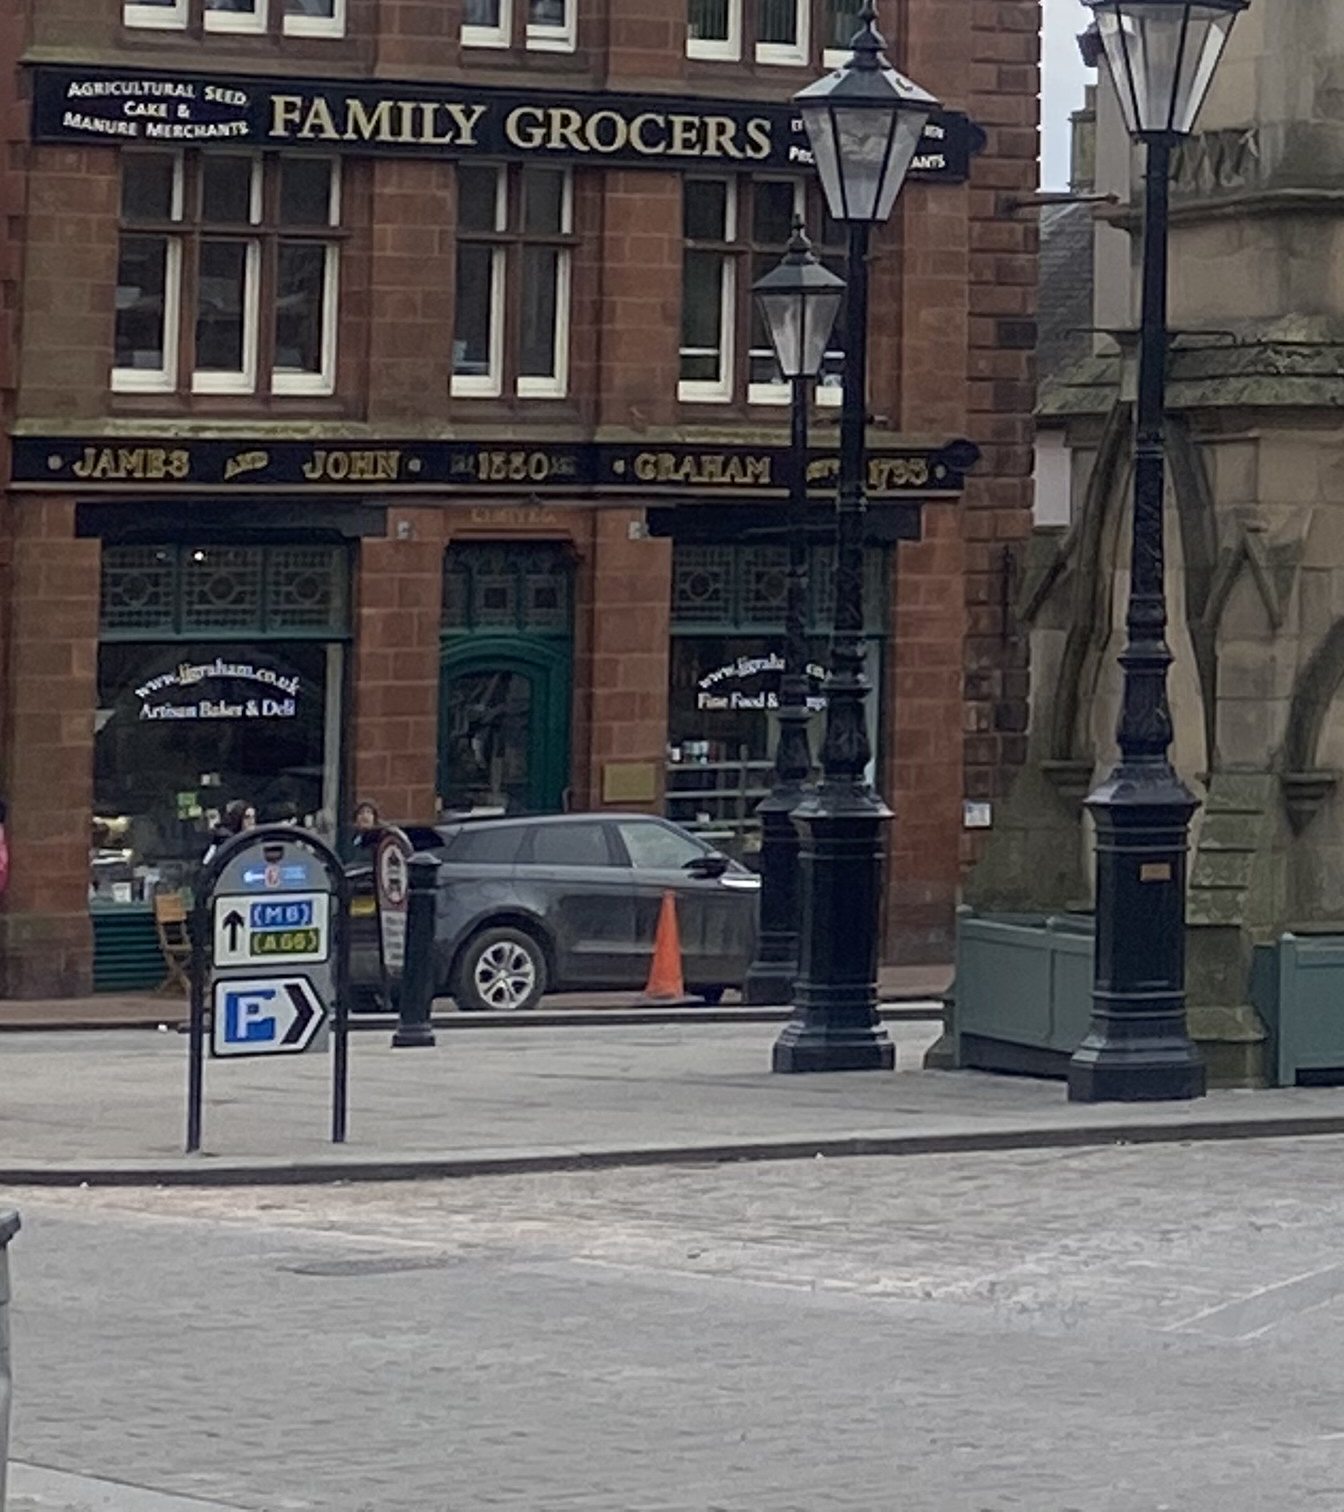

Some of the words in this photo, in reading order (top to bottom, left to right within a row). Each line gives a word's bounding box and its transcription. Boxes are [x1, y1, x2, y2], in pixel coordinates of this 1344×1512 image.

[67, 81, 196, 98] AGRICULTURAL
[204, 86, 248, 106] SEED
[123, 100, 169, 118] CAKE
[176, 103, 191, 119] &
[62, 111, 138, 137] MANURE
[145, 120, 249, 139] MERCHANTS
[268, 94, 487, 146] FAMILY
[504, 105, 773, 160] GROCERS
[73, 447, 191, 479] JAMES
[302, 450, 401, 480] JOHN
[633, 452, 773, 484] GRAHAM
